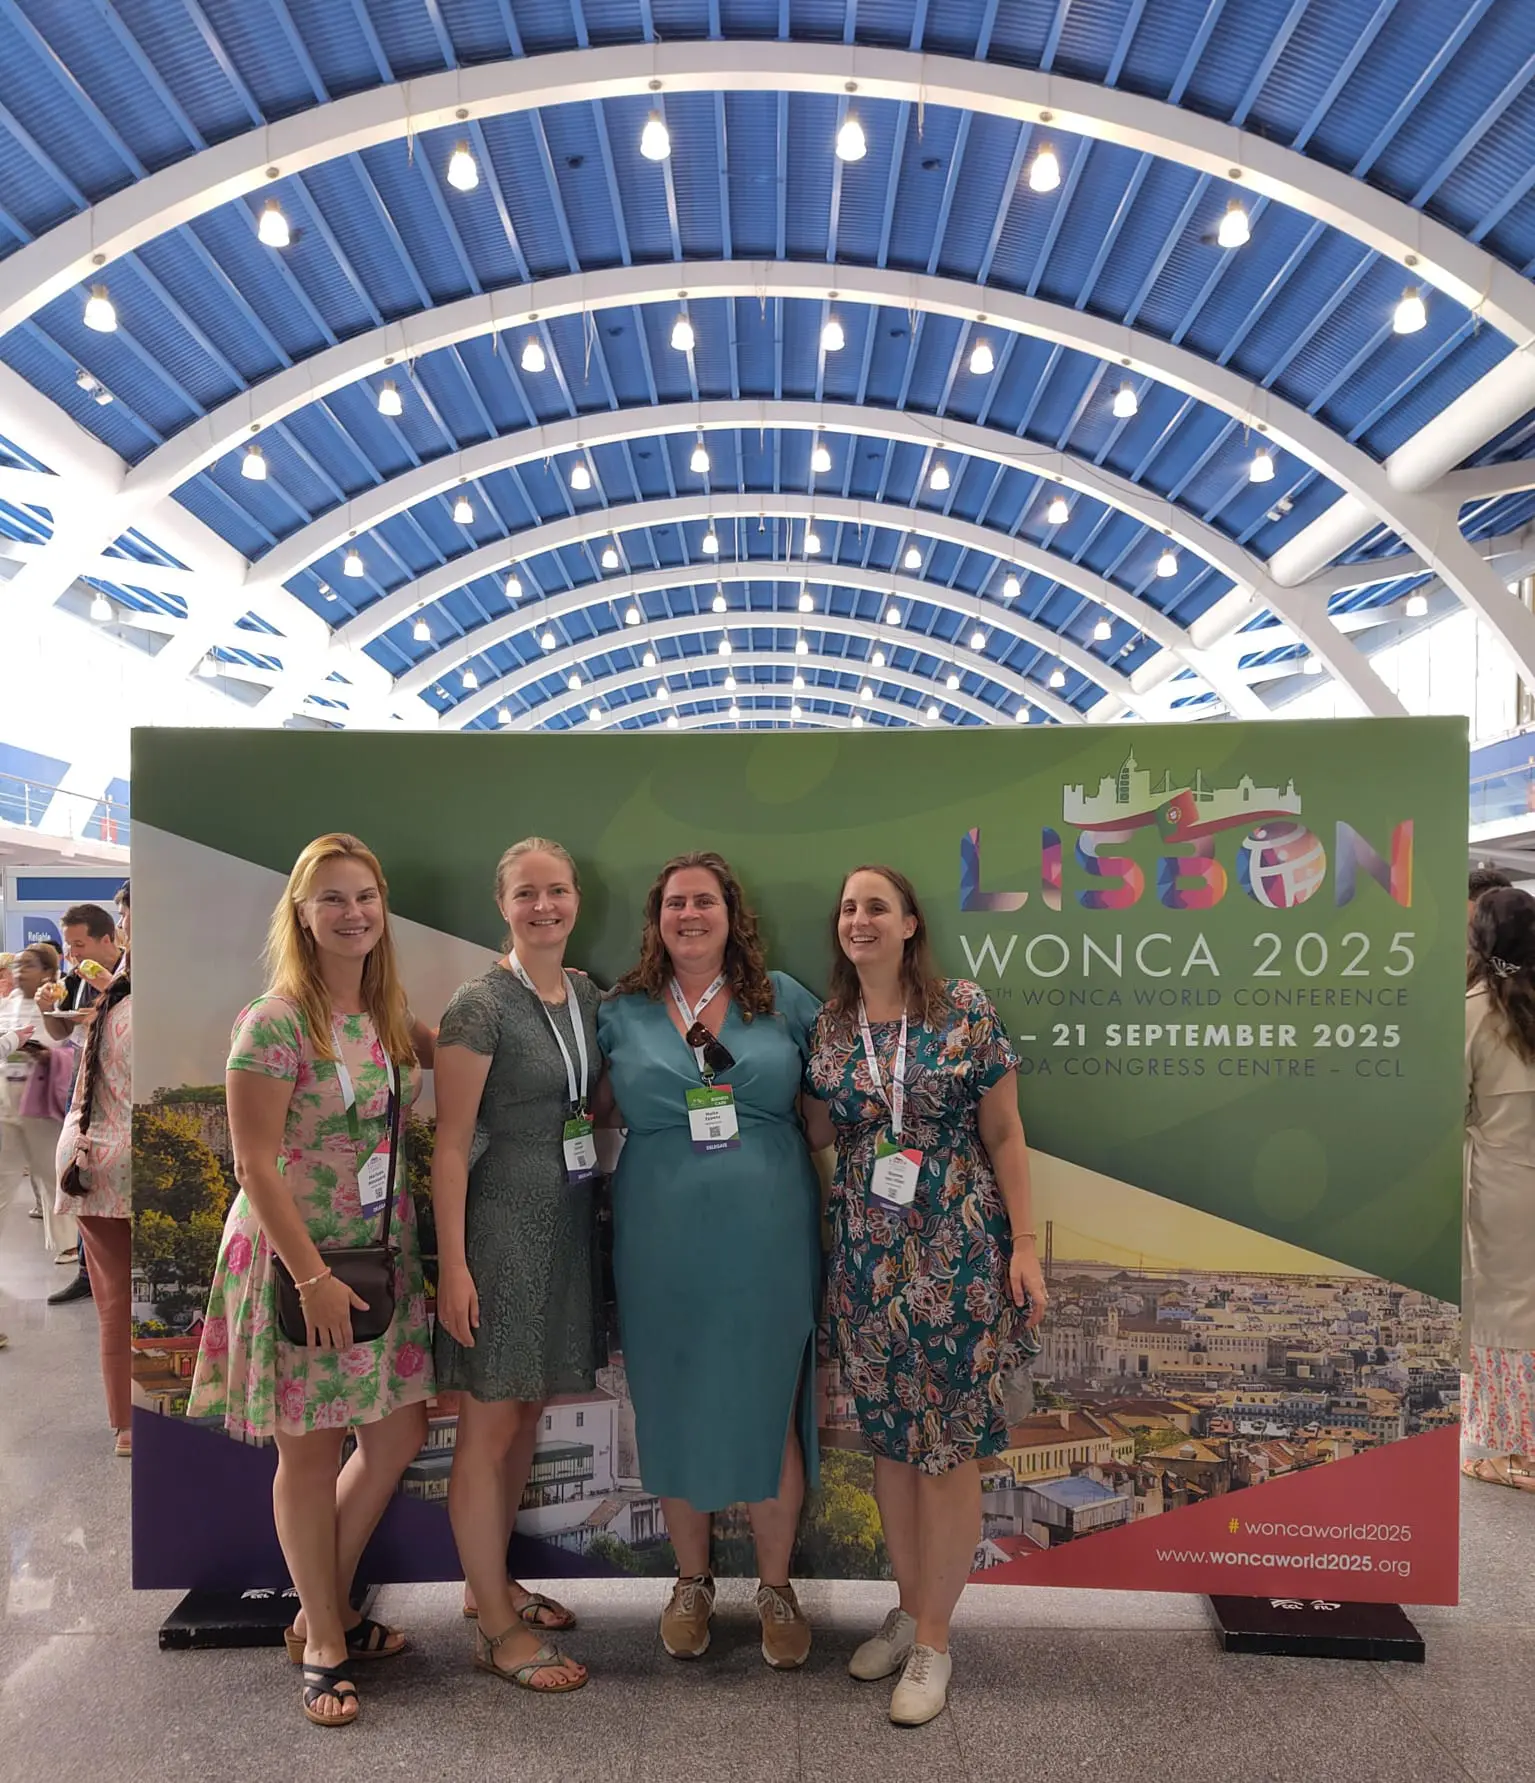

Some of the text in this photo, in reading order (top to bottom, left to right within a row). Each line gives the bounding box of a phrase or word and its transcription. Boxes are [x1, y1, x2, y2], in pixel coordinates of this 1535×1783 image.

[960, 819, 1415, 912] LISBON
[959, 932, 1416, 979] WONCA 2025
[1022, 988, 1123, 1007] WONCA
[1134, 988, 1222, 1007] WORLD
[1234, 988, 1408, 1007] CONFERENCE
[1052, 1023, 1086, 1046] 21
[1105, 1023, 1298, 1047] SEPTEMBER
[1312, 1023, 1401, 1048] 2025
[1064, 1057, 1206, 1077] CONGRESS
[1217, 1057, 1315, 1077] CENTRE
[1355, 1058, 1405, 1078] CCL
[1244, 1520, 1412, 1541] woncaworld2025
[1155, 1547, 1412, 1578] www.woncaworld2025.org
